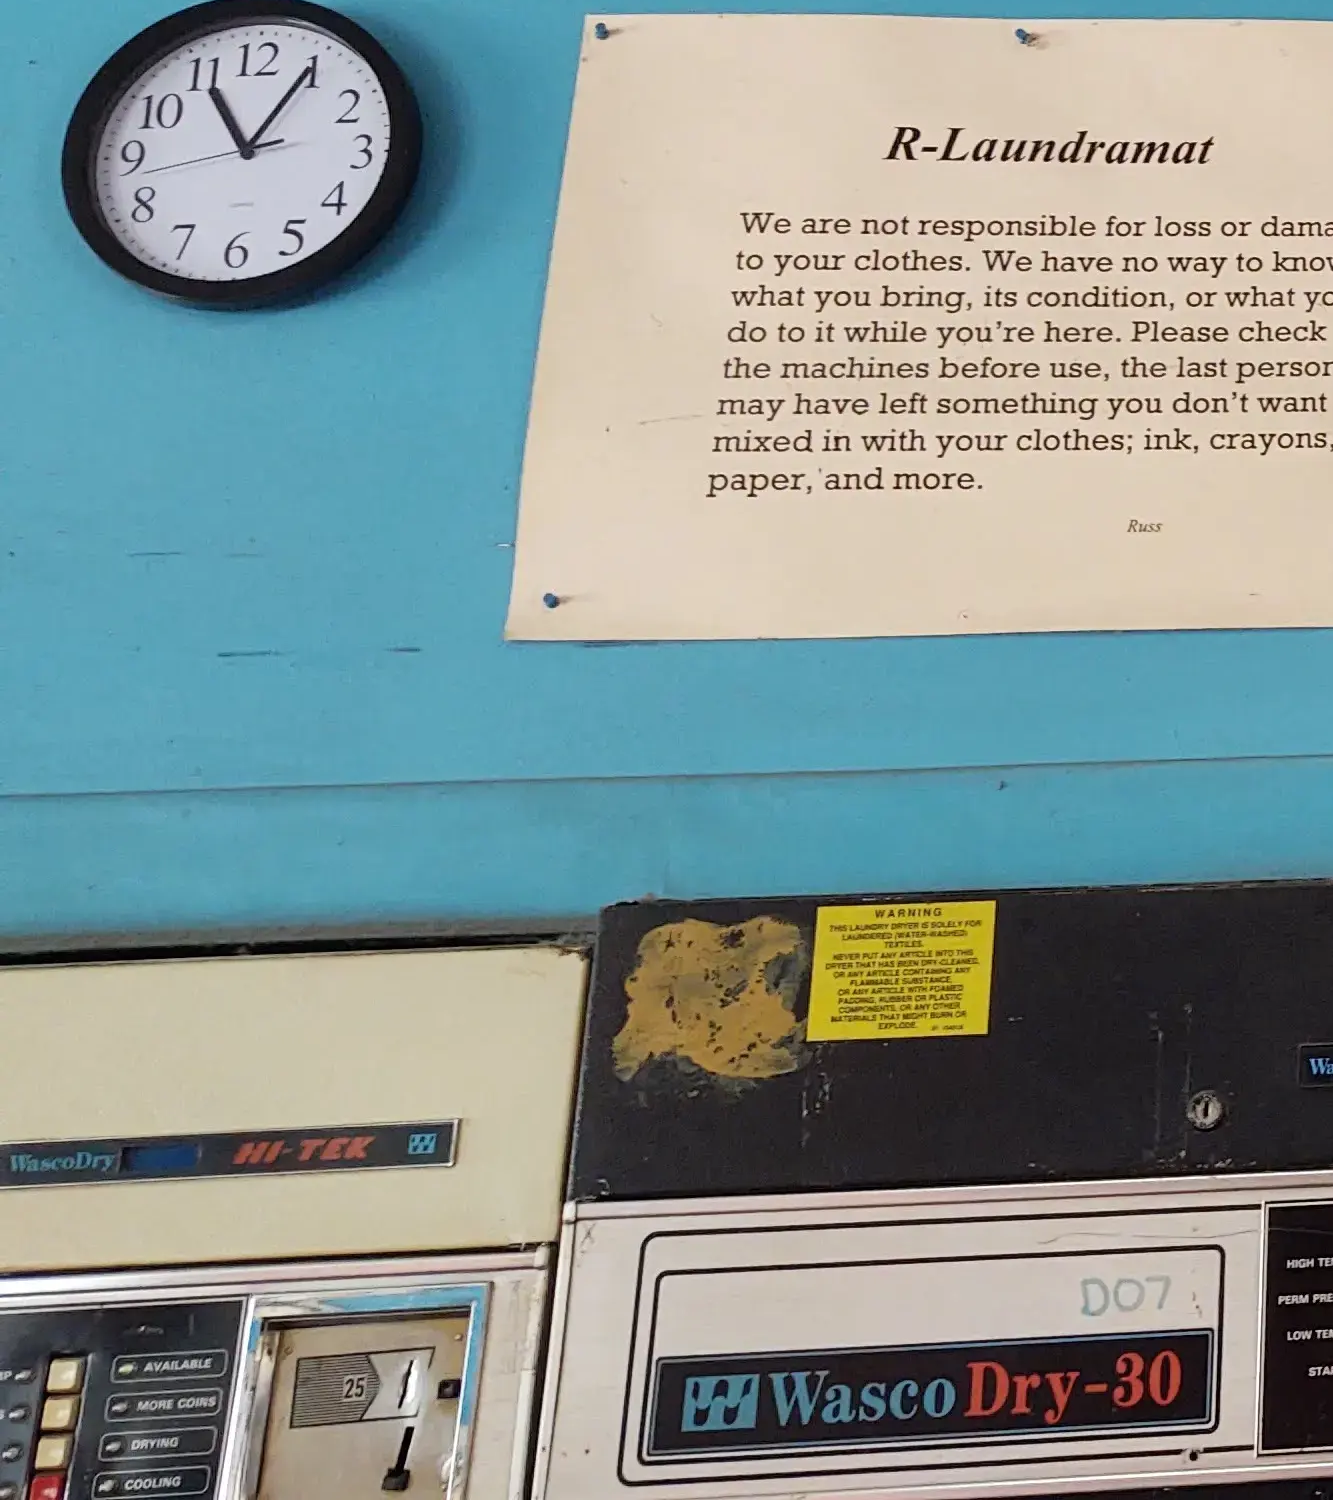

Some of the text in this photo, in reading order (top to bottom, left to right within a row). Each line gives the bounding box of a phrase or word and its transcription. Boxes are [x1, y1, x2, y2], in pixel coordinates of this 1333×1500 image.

[187, 57, 219, 91] 11
[236, 42, 279, 76] 12
[304, 55, 320, 88] 1
[139, 93, 183, 129] 10
[335, 89, 360, 123] 2
[120, 140, 145, 176] 9
[350, 134, 372, 169] 3
[881, 126, 1215, 165] R-Laundramat
[132, 187, 155, 222] 8
[321, 181, 347, 216] 4
[170, 224, 196, 260] 7
[279, 219, 306, 256] 5
[739, 211, 792, 235] We
[800, 217, 852, 235] are
[860, 215, 910, 236] not
[917, 214, 1097, 243] responsible
[1104, 215, 1148, 238] for
[1153, 215, 1212, 237] loss
[1220, 221, 1253, 238] or
[224, 232, 251, 268] 6
[735, 250, 765, 271] to
[773, 254, 847, 277] your
[853, 248, 971, 272] clothes.
[981, 249, 1033, 273] We
[1040, 250, 1114, 273] have
[1121, 256, 1159, 273] no
[1166, 256, 1229, 279] way
[1235, 252, 1264, 273] to
[730, 284, 806, 307] what
[813, 290, 872, 314] you
[879, 284, 973, 314] bring,
[983, 285, 1018, 308] its
[1026, 285, 1175, 312] condition,
[1185, 291, 1218, 308] or
[1223, 285, 1296, 308] what
[727, 319, 1328, 349] do to it while you're here. Please check
[723, 356, 772, 379] the
[779, 356, 930, 379] machines
[937, 356, 1041, 379] before
[1049, 362, 1110, 382] use,
[1120, 355, 1168, 379] the
[1175, 355, 1229, 378] last
[715, 391, 1328, 422] may have left something you don't want
[711, 429, 814, 453] mixed
[821, 429, 853, 452] in
[860, 428, 927, 452] with
[935, 434, 1009, 459] your
[1015, 428, 1133, 455] clothes;
[1143, 427, 1199, 455] ink,
[705, 466, 984, 499] paper, and more.
[1126, 519, 1164, 533] Russ
[875, 908, 942, 918] WARNING
[10, 1136, 375, 1174] WascoDry HI-TEK
[1287, 1259, 1314, 1269] HIGH
[1278, 1294, 1309, 1305] PERM
[1287, 1330, 1312, 1341] LOW
[144, 1357, 213, 1373] AVAILABLE
[136, 1396, 217, 1412] MORE COINS
[344, 1377, 365, 1399] 25
[131, 1437, 179, 1451] DRYING
[123, 1475, 181, 1491] COOLING
